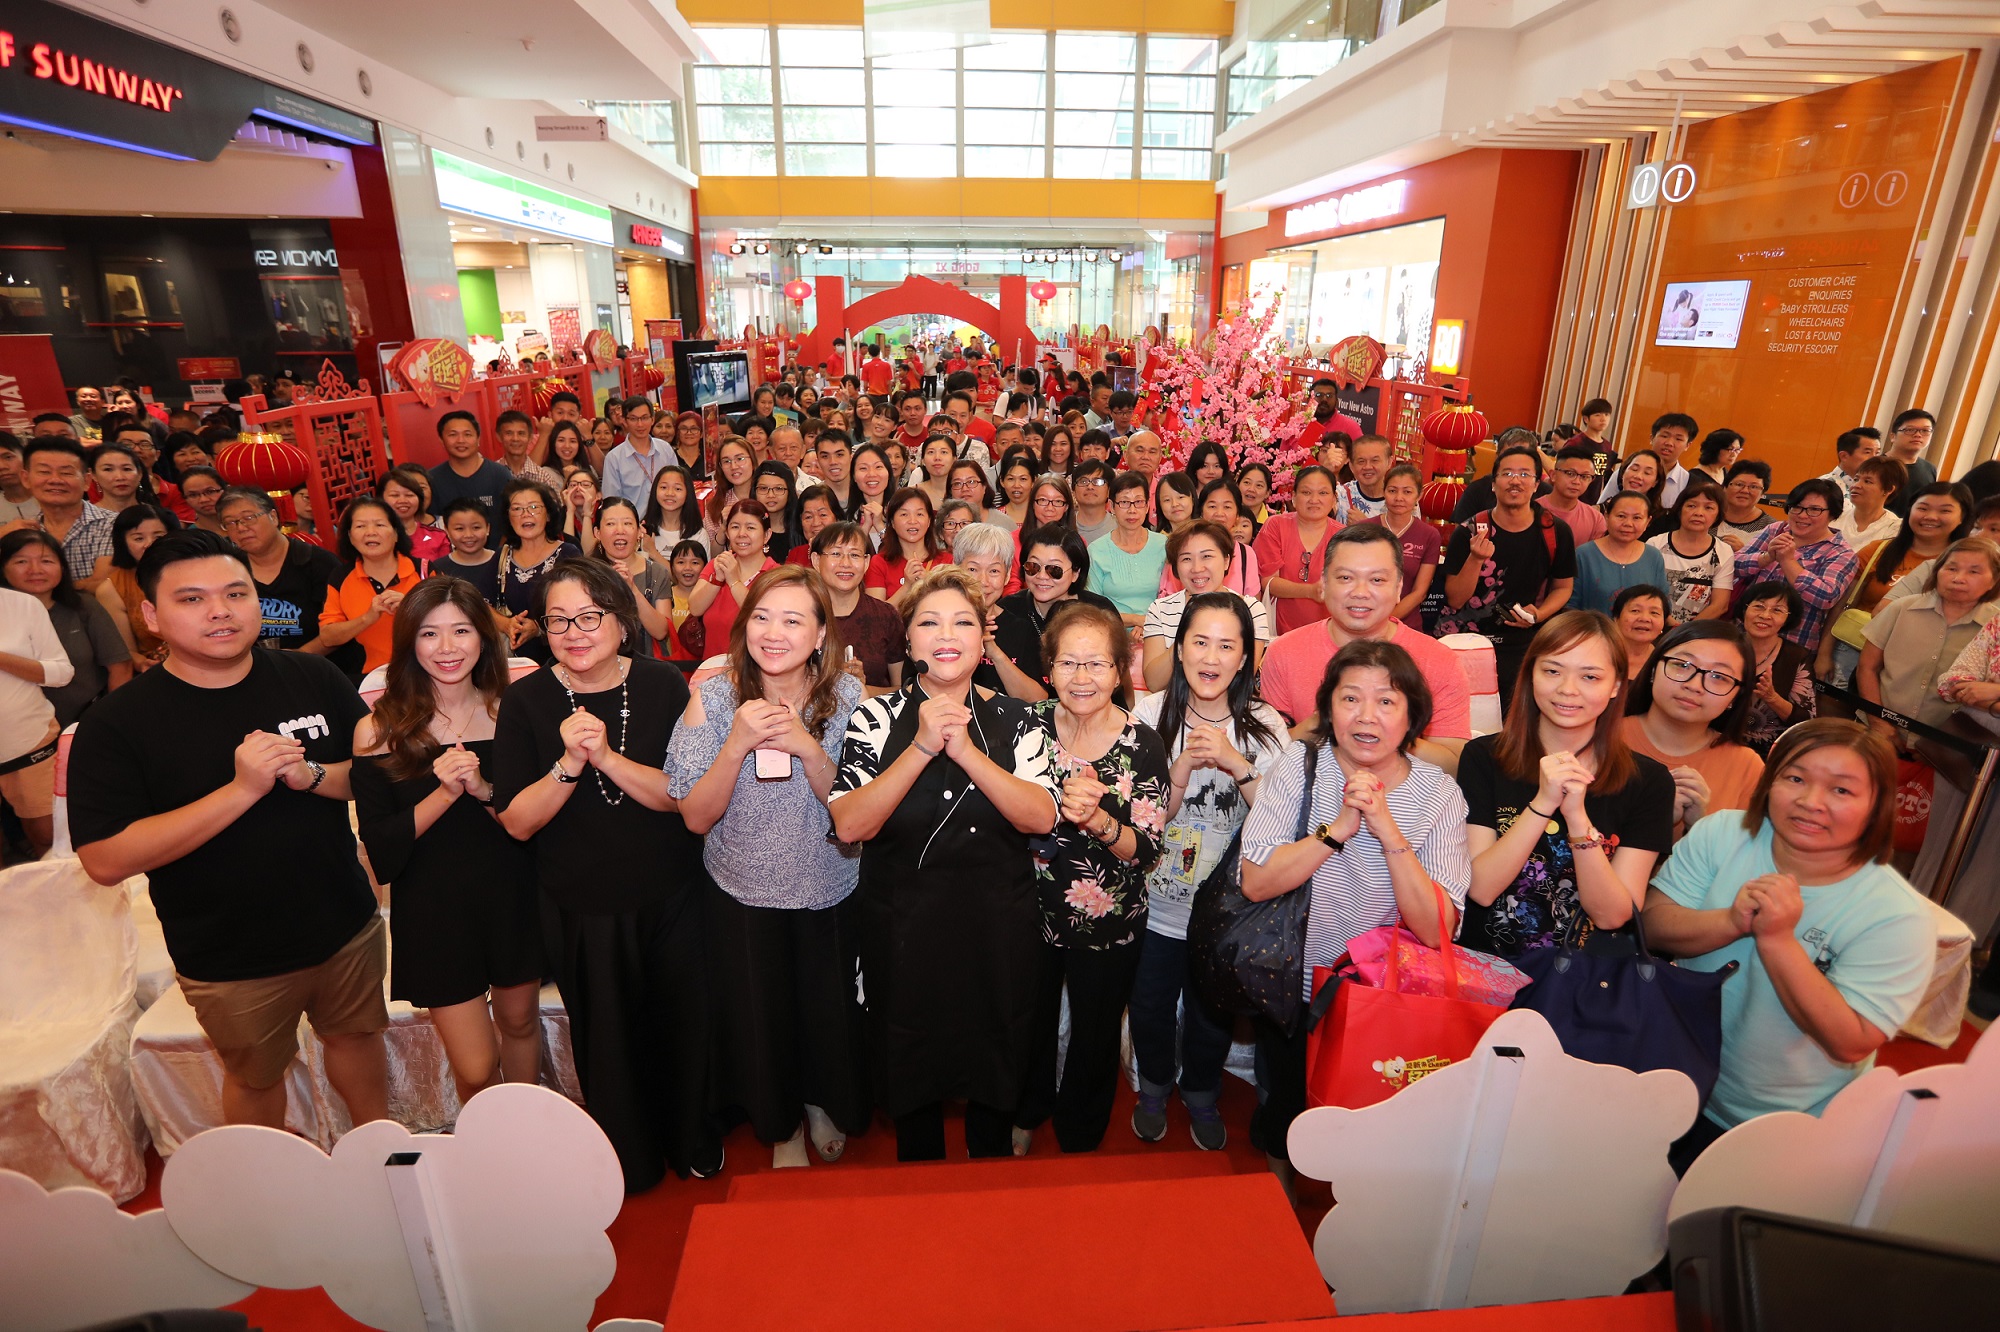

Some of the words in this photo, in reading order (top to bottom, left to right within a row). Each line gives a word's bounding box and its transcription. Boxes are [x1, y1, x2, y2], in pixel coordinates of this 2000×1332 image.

[32, 43, 173, 112] SUNWAY
[1788, 277, 1831, 288] CUSTOMER
[1833, 276, 1857, 286] CARE
[1808, 290, 1853, 300] ENQUIRIES
[1780, 304, 1801, 314] BABY
[1802, 304, 1849, 314] STROLLERS
[1789, 317, 1845, 327] WHEELCHAIRS
[1785, 331, 1805, 340] LOST
[1806, 331, 1812, 340] &
[1813, 331, 1841, 341] FOUND
[1767, 342, 1804, 352] SECURITY
[1805, 344, 1838, 354] ESCORT
[1338, 398, 1349, 409] Your
[1349, 400, 1360, 411] New
[1360, 403, 1374, 415] Astro
[1403, 542, 1424, 554] 2nd
[1881, 711, 1909, 725] VELOCITY
[1895, 793, 1931, 814] OTO
